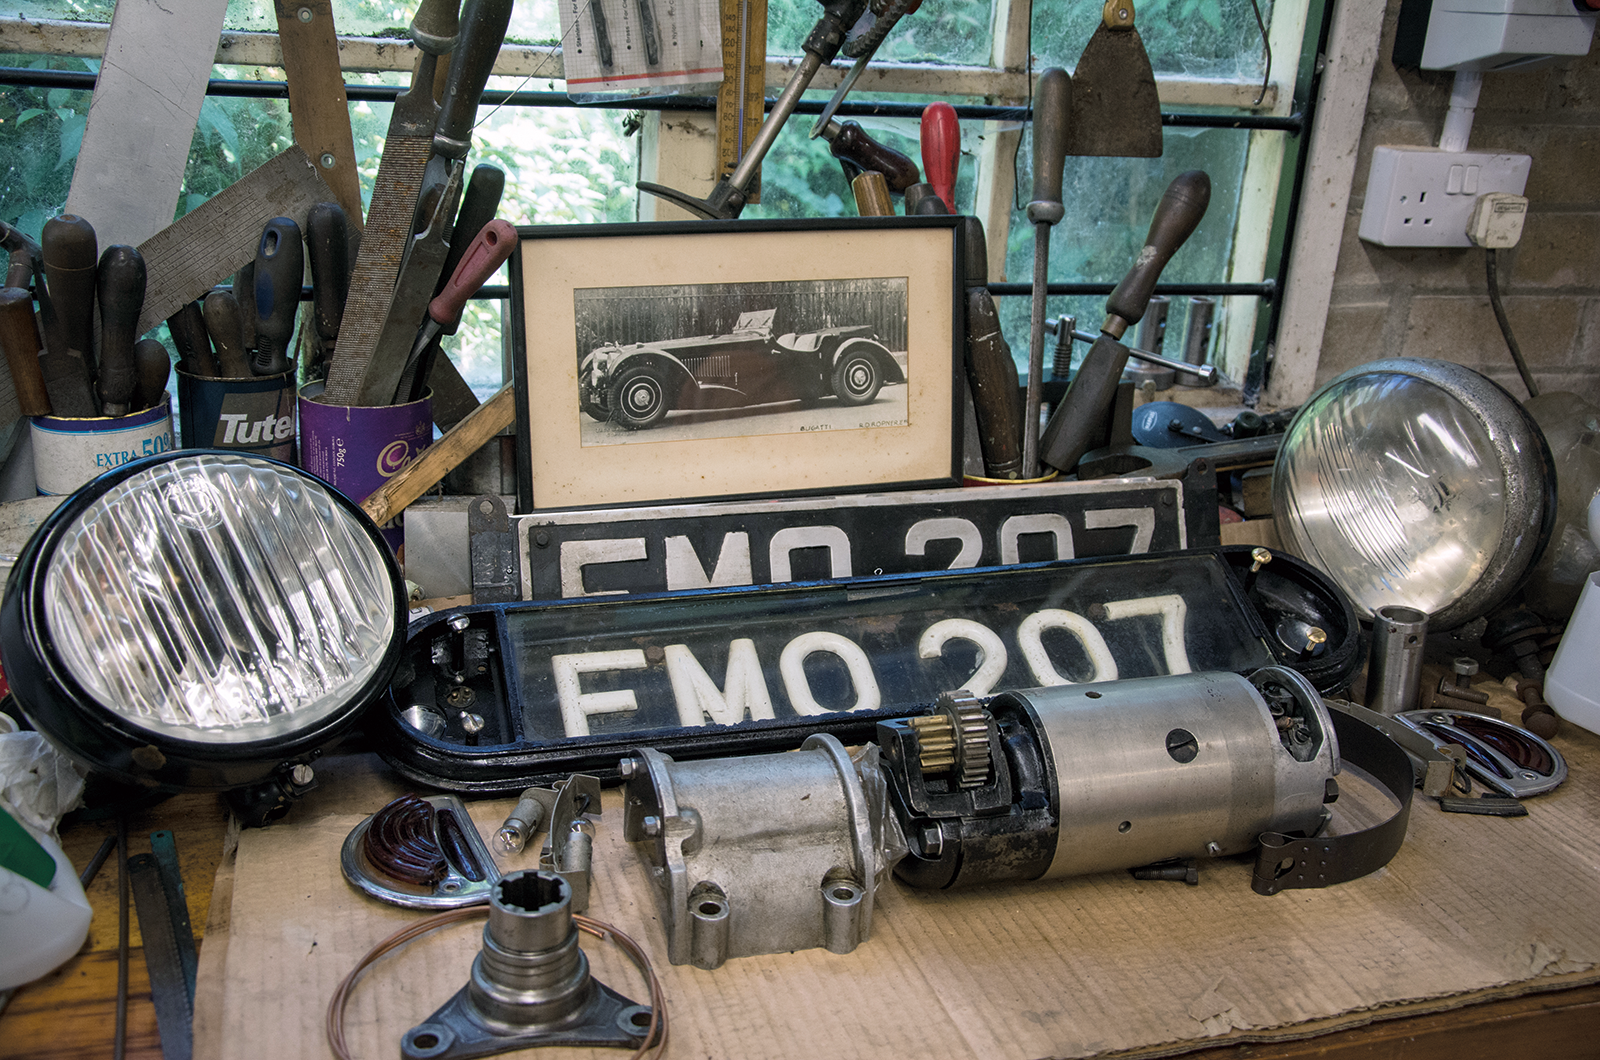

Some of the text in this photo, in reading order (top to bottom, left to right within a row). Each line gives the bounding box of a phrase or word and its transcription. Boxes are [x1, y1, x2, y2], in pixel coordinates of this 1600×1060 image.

[800, 424, 832, 432] BUGATTI
[96, 449, 138, 467] EXTRA
[336, 448, 347, 468] 750g
[918, 594, 1192, 699] 207
